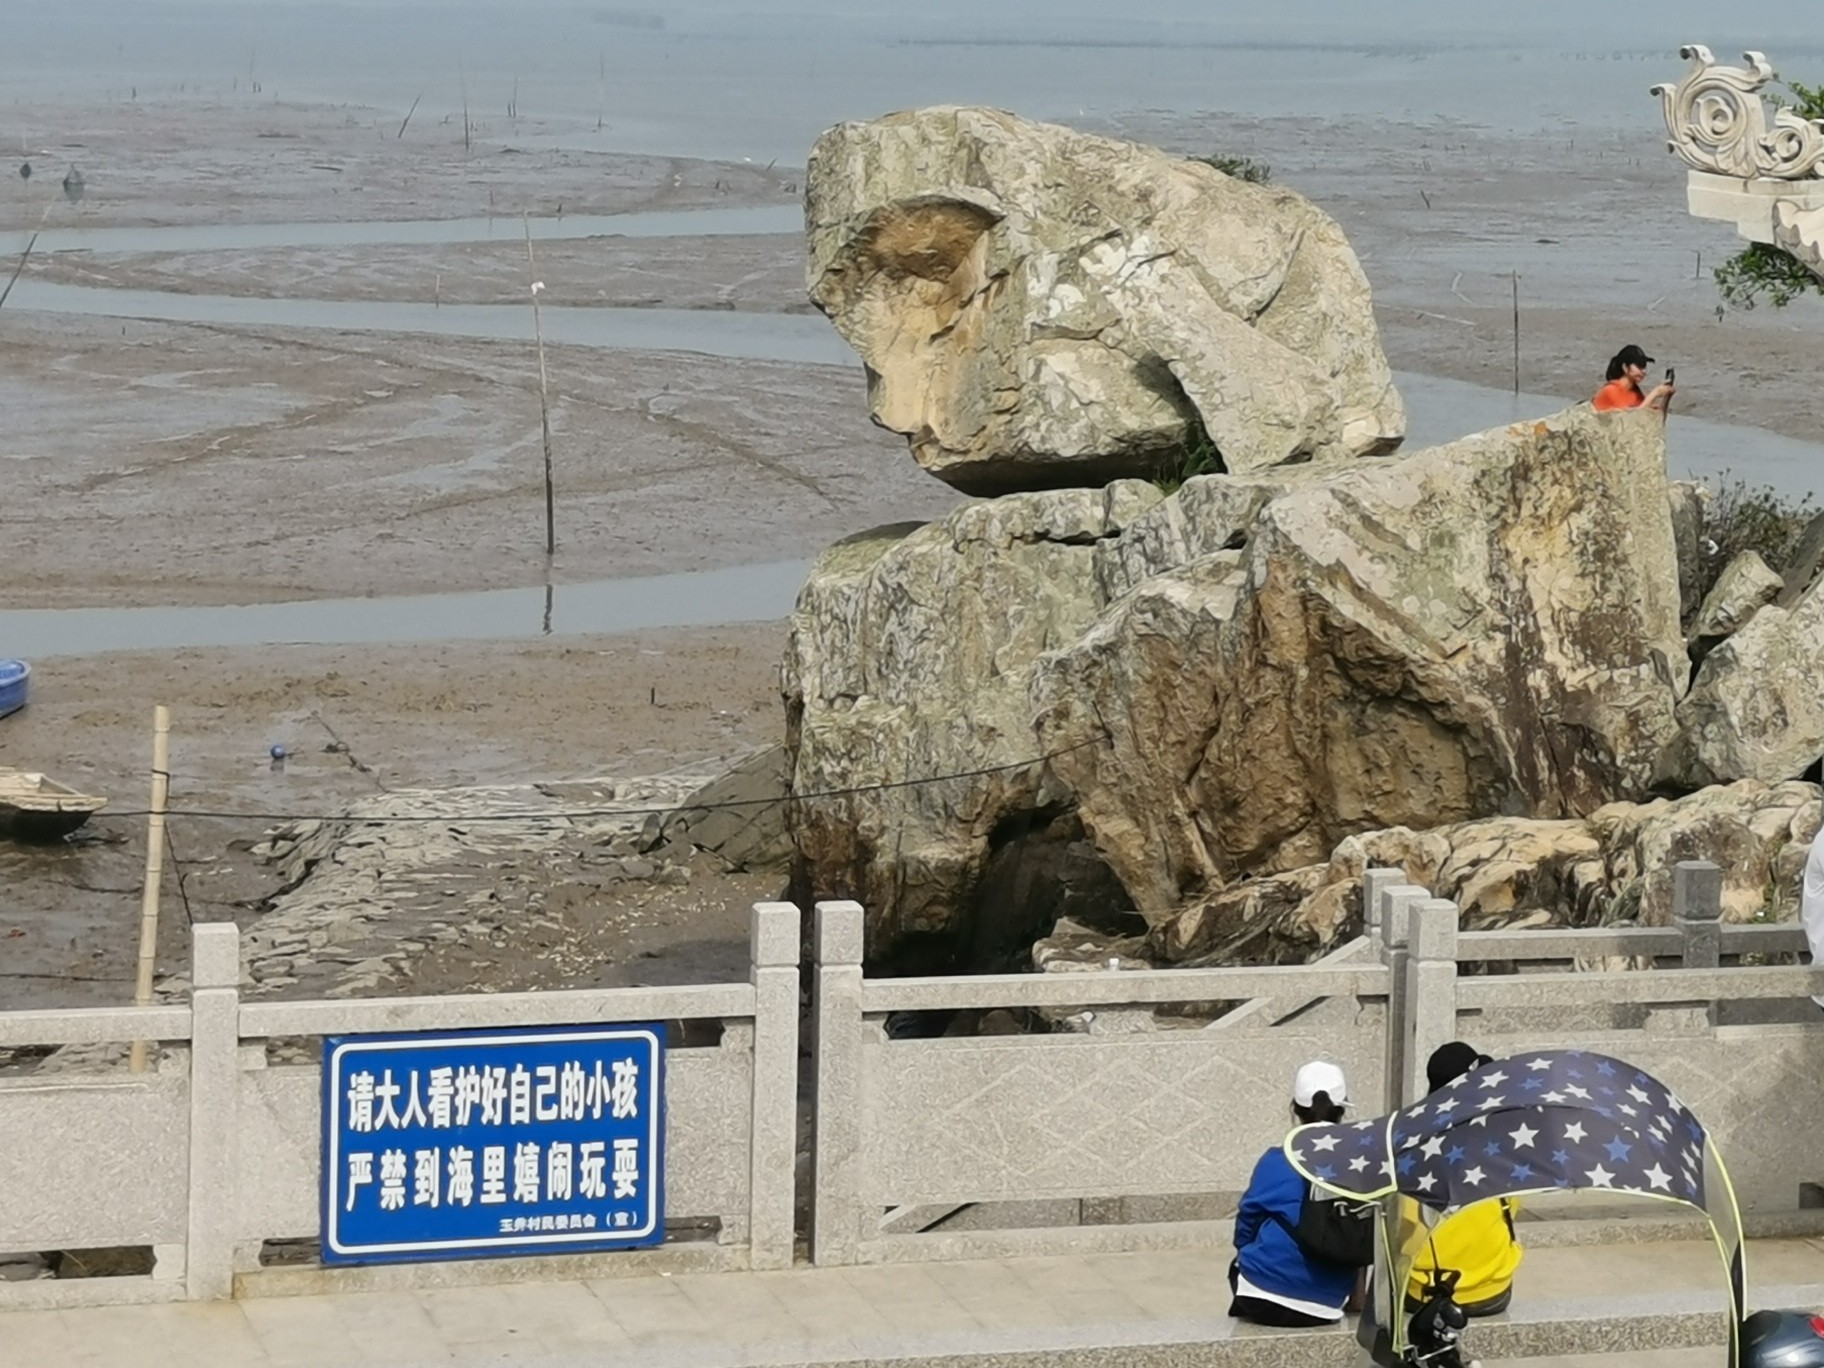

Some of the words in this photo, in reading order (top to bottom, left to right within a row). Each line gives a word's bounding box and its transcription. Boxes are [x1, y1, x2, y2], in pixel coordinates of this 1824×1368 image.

[347, 1057, 639, 1132] 请大人看护好自己的小孩
[346, 1138, 639, 1212] 严禁到海里嬉闹玩耍
